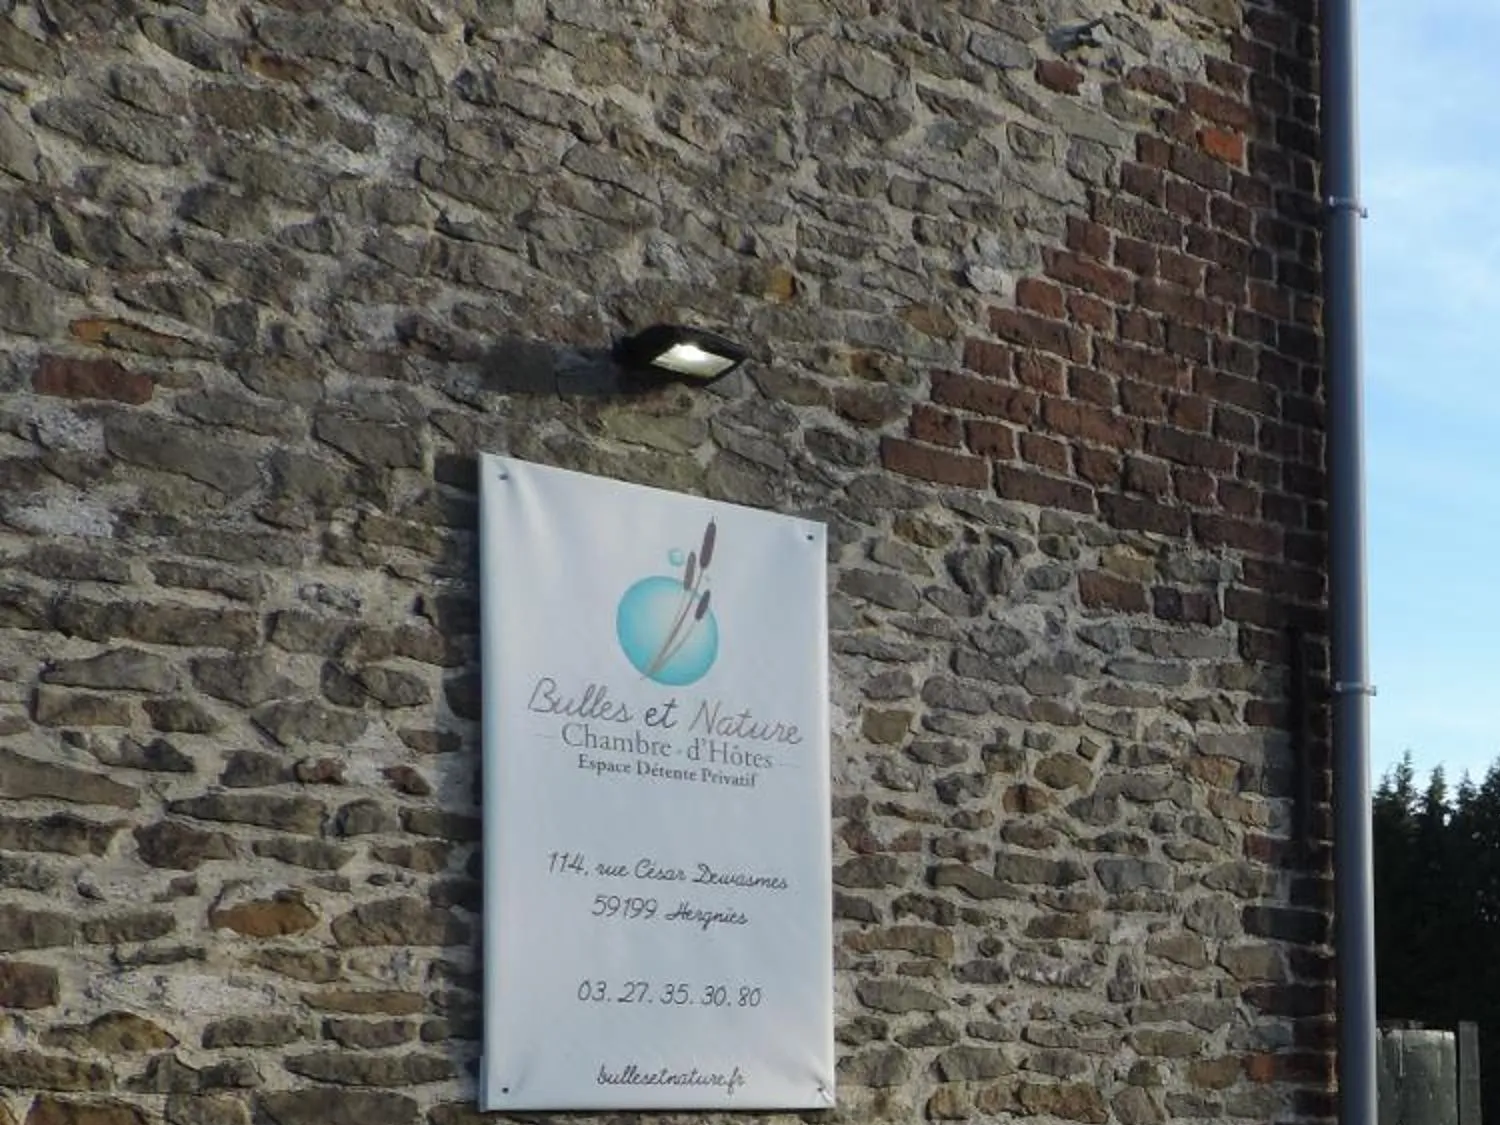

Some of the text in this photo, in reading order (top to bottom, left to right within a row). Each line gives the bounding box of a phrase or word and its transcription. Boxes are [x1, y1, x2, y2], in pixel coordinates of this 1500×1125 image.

[528, 677, 803, 745] Bulles et Nature
[561, 722, 774, 770] Chambre d'Hôtes
[577, 754, 757, 788] Espace Détente Privatif
[598, 863, 629, 878] rue
[692, 863, 788, 889] Dewasmes
[592, 894, 748, 929] 59199 Hergnies
[597, 1064, 745, 1094] bullesetnature.fr
